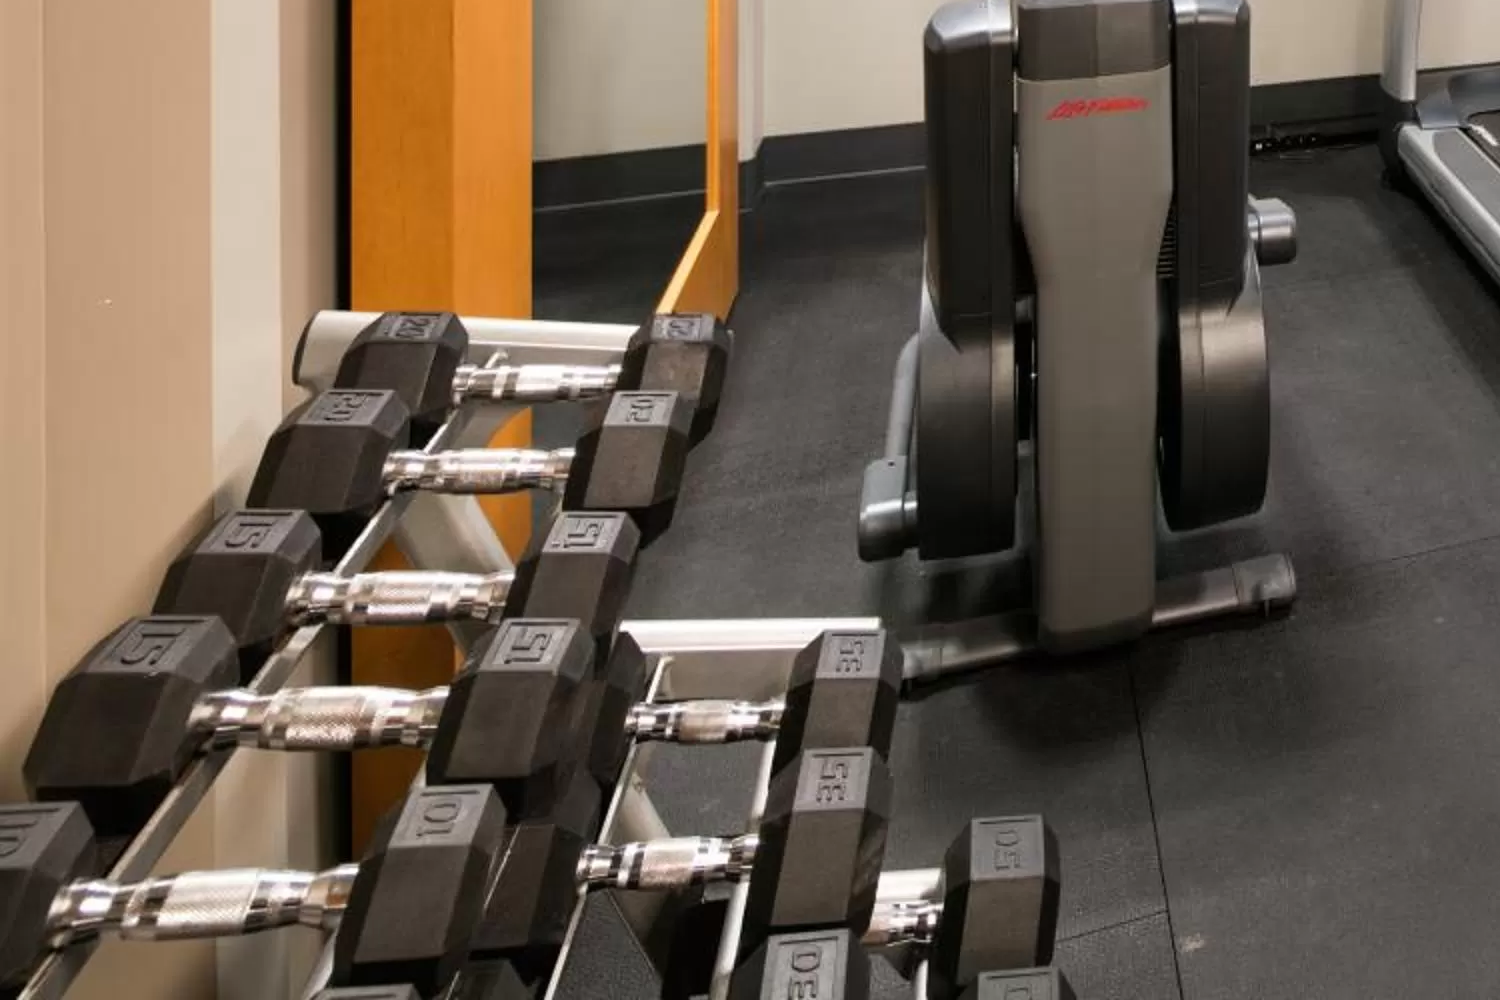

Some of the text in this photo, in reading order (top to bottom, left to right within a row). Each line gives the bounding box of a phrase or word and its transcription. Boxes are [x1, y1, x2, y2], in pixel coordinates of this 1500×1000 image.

[627, 399, 656, 422] 20
[225, 522, 274, 549] 15
[563, 521, 603, 549] 15
[119, 632, 180, 666] 15
[504, 631, 551, 665] 15
[836, 639, 864, 672] 35
[816, 762, 847, 801] 35
[415, 800, 463, 838] 10
[993, 829, 1021, 872] 50
